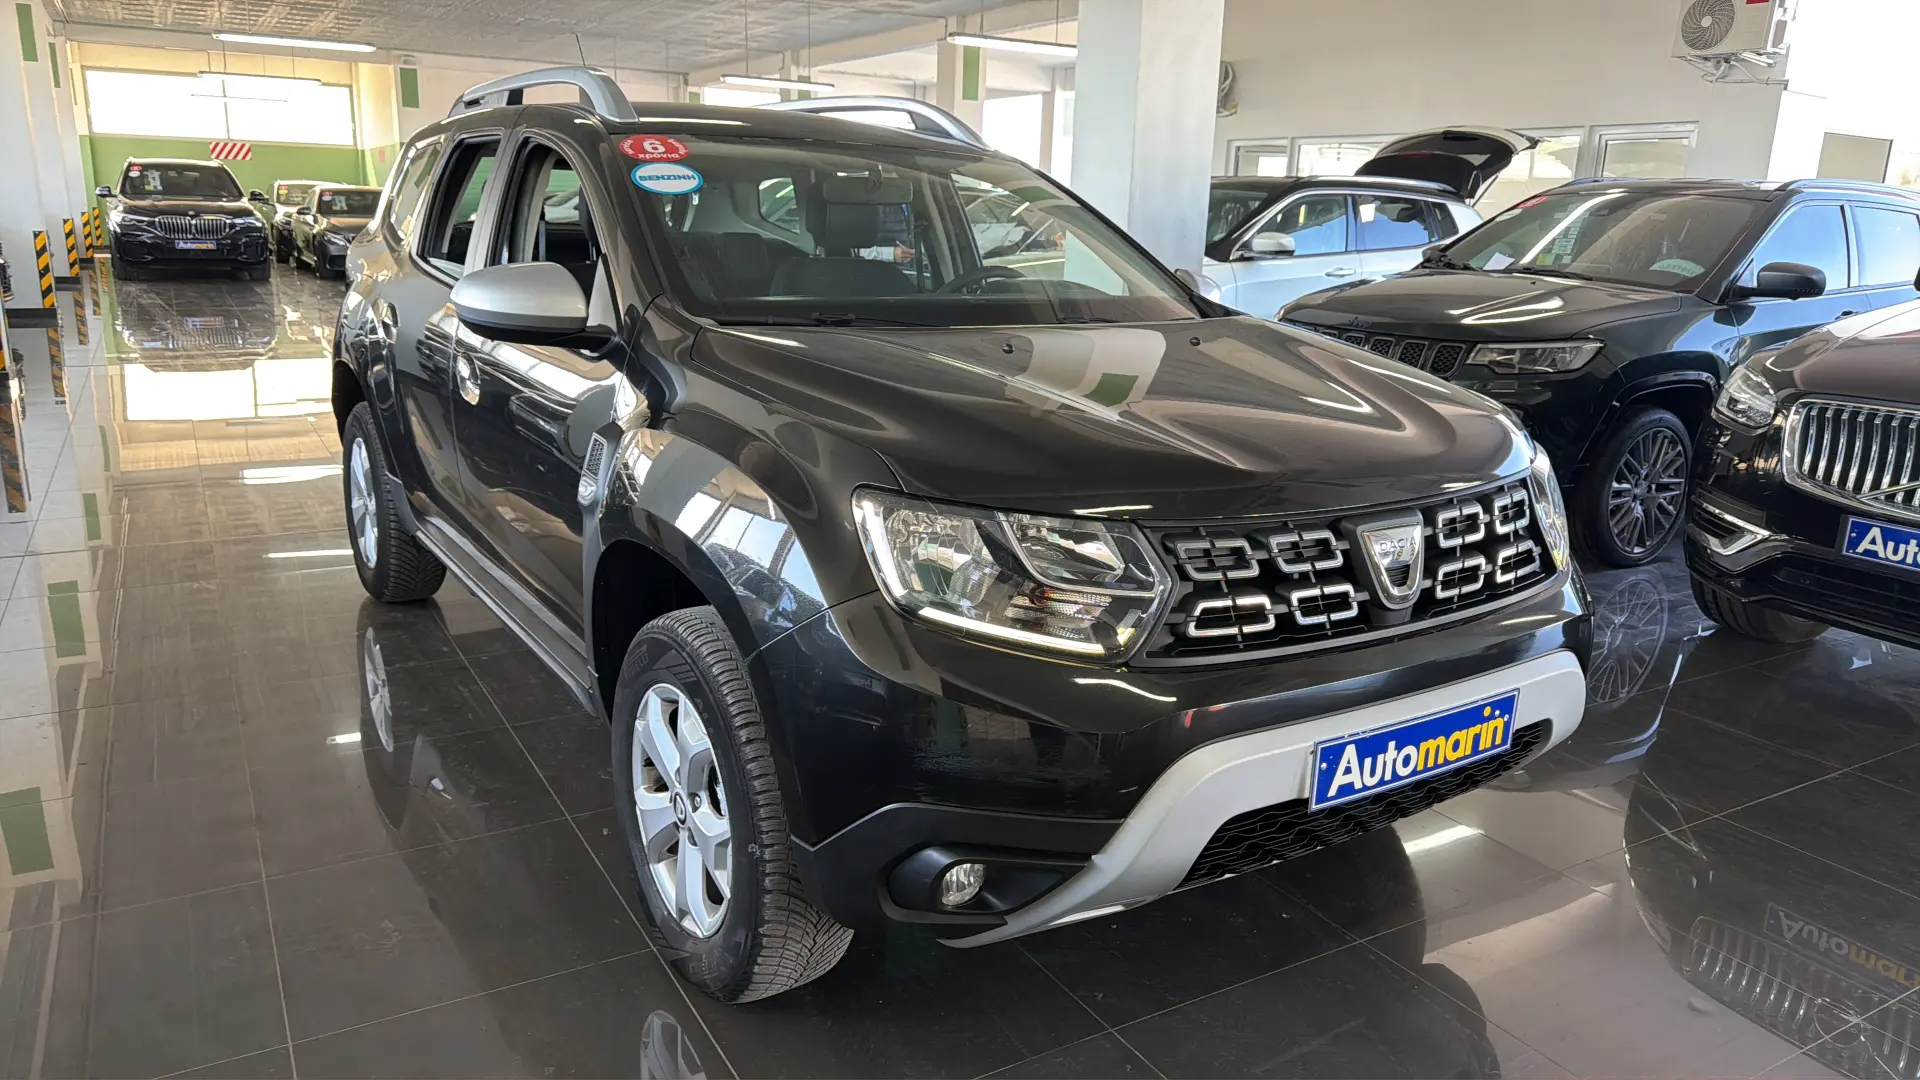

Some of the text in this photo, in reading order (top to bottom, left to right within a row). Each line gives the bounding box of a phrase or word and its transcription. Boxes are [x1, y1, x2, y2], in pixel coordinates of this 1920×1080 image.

[643, 138, 666, 153] 6
[637, 152, 680, 160] χρόνια
[1379, 536, 1417, 552] DACIA
[1855, 526, 1920, 566] Aut
[1327, 705, 1506, 798] Automarin
